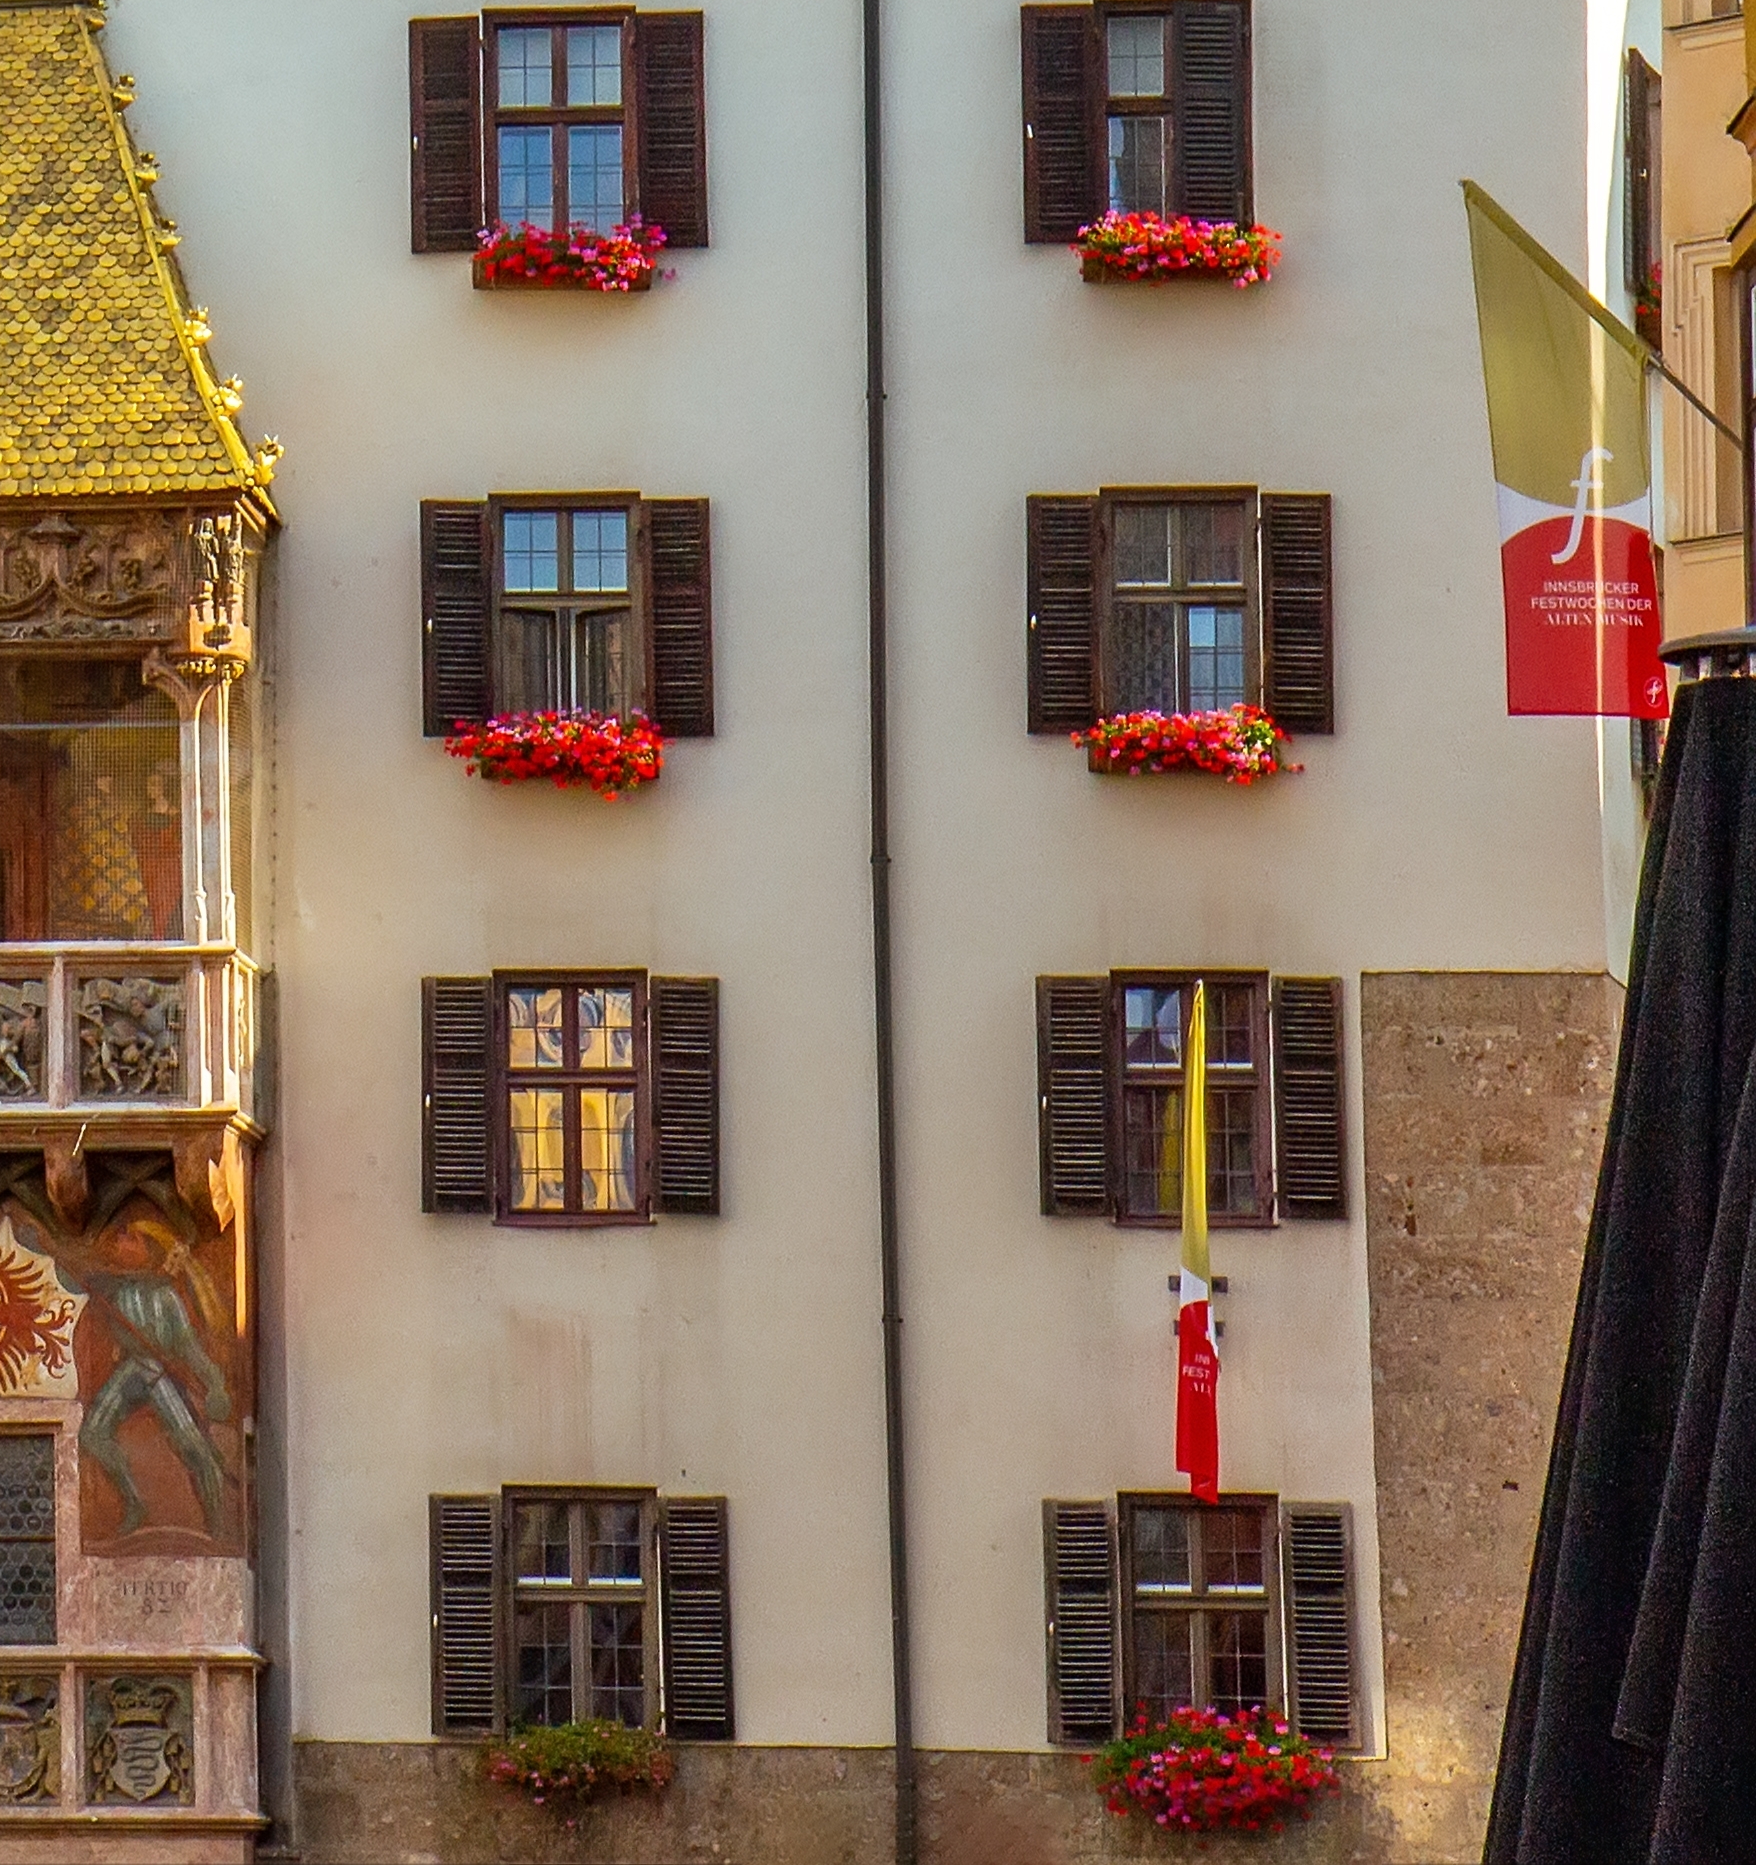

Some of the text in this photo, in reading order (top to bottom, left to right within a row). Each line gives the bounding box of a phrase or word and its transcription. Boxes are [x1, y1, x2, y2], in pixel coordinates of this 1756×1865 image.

[1531, 596, 1653, 611] FESTWOCHEN DER
[1546, 613, 1593, 627] ALTEN
